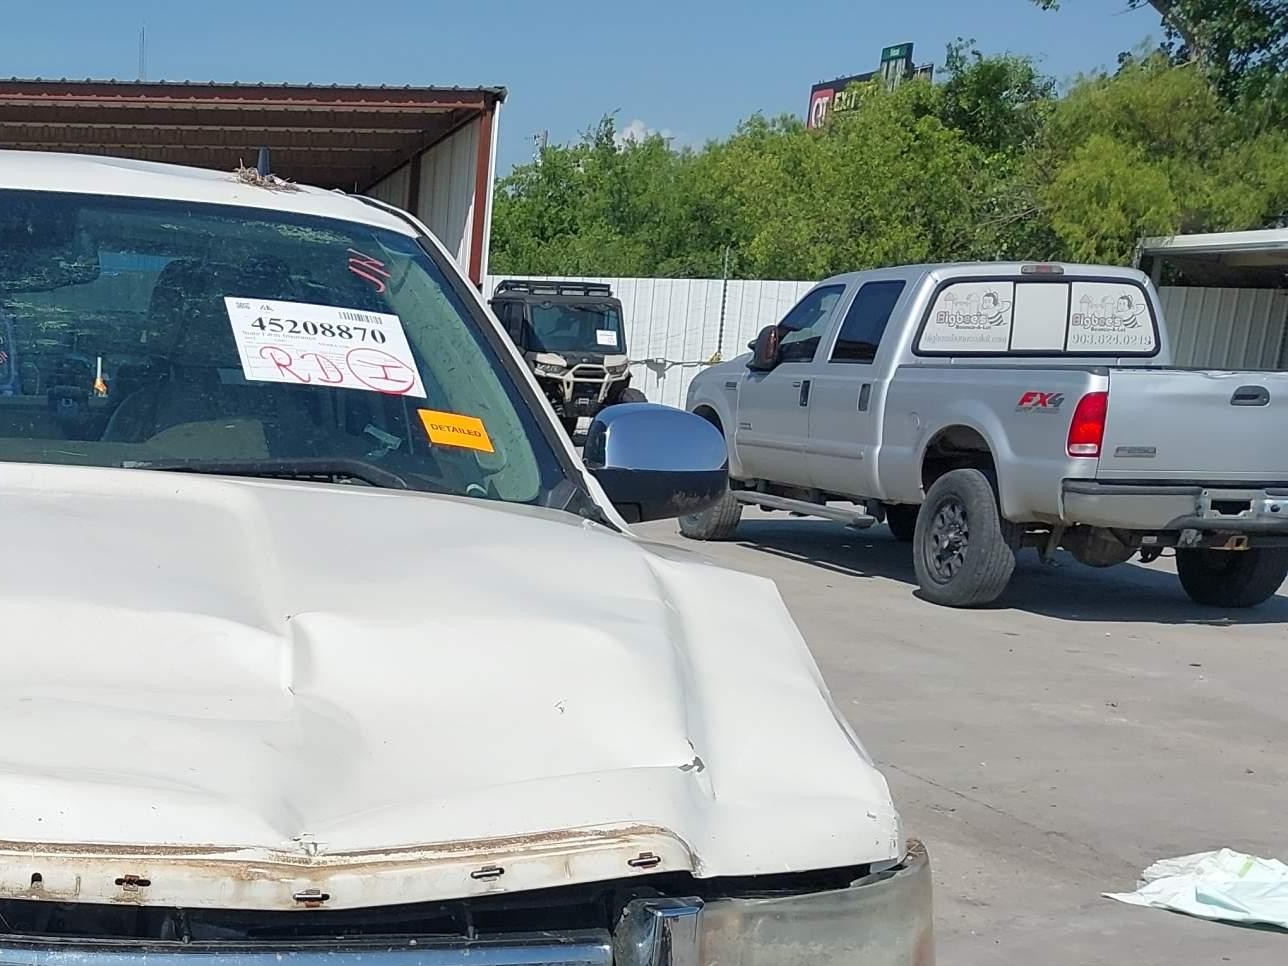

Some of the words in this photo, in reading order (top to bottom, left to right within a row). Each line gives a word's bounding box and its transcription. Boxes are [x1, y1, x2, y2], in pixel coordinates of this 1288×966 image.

[251, 316, 387, 345] 45208870
[1016, 391, 1065, 408] FX4
[430, 423, 482, 438] DETAILED
